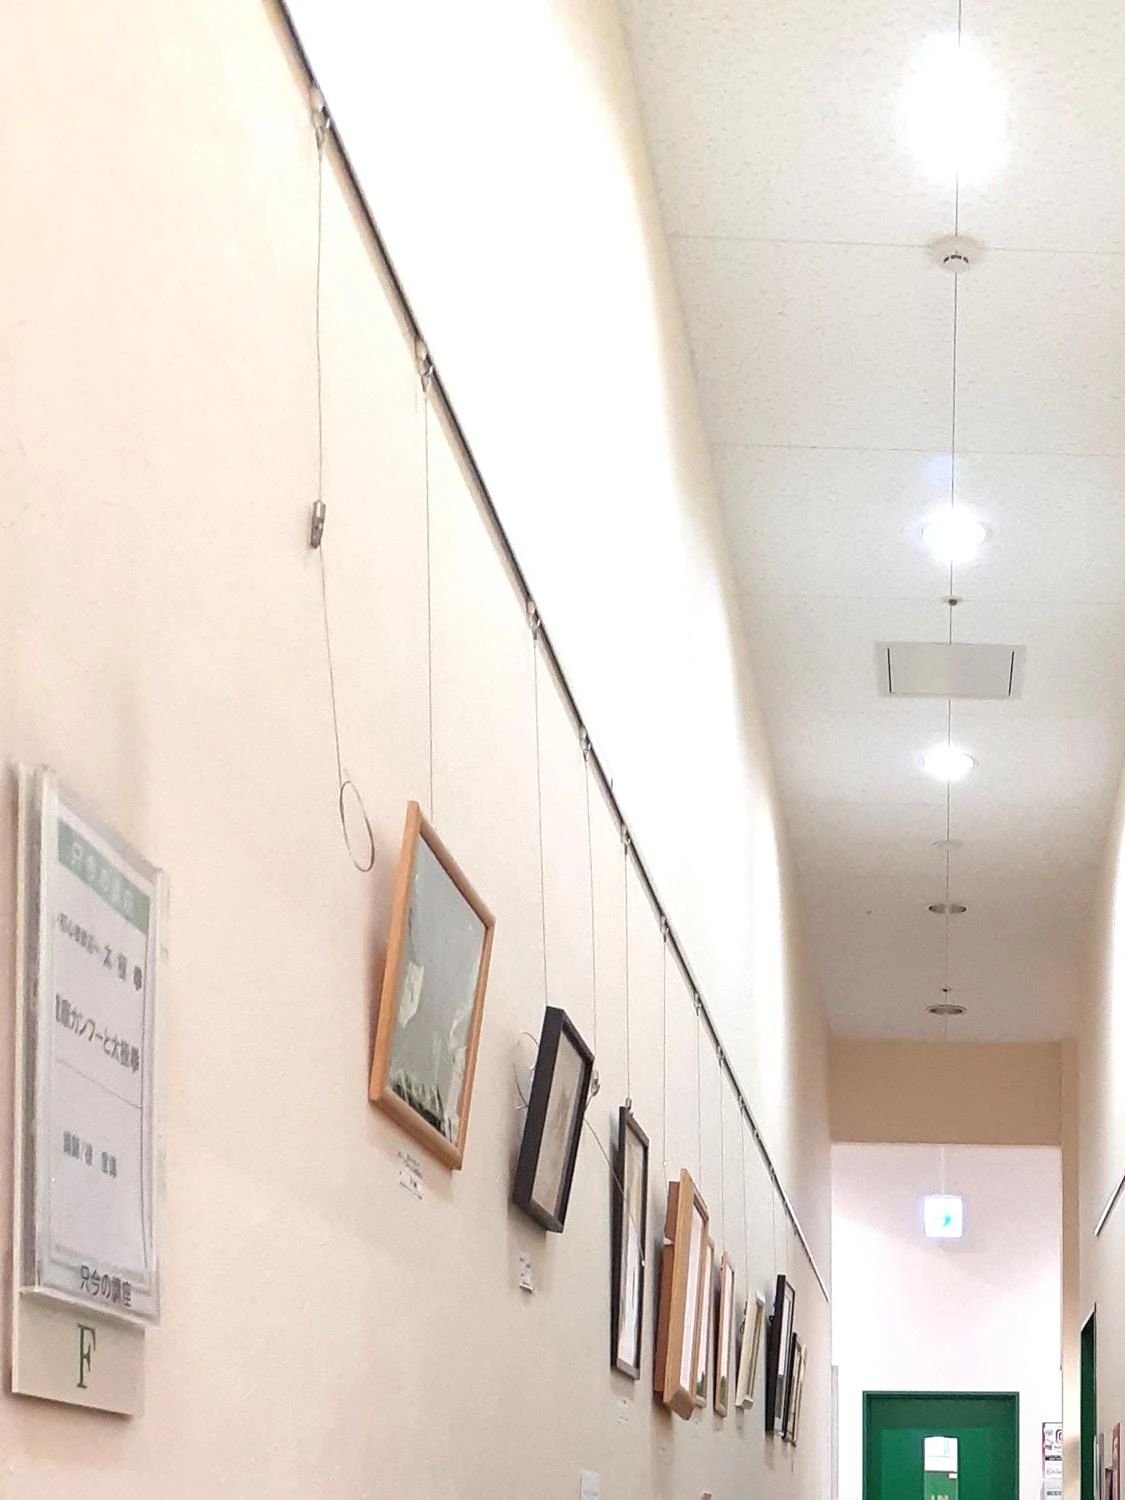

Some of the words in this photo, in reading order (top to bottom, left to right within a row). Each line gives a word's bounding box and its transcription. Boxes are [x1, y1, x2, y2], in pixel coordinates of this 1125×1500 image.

[80, 1265, 132, 1308] 只今の講座
[77, 1323, 96, 1389] F
